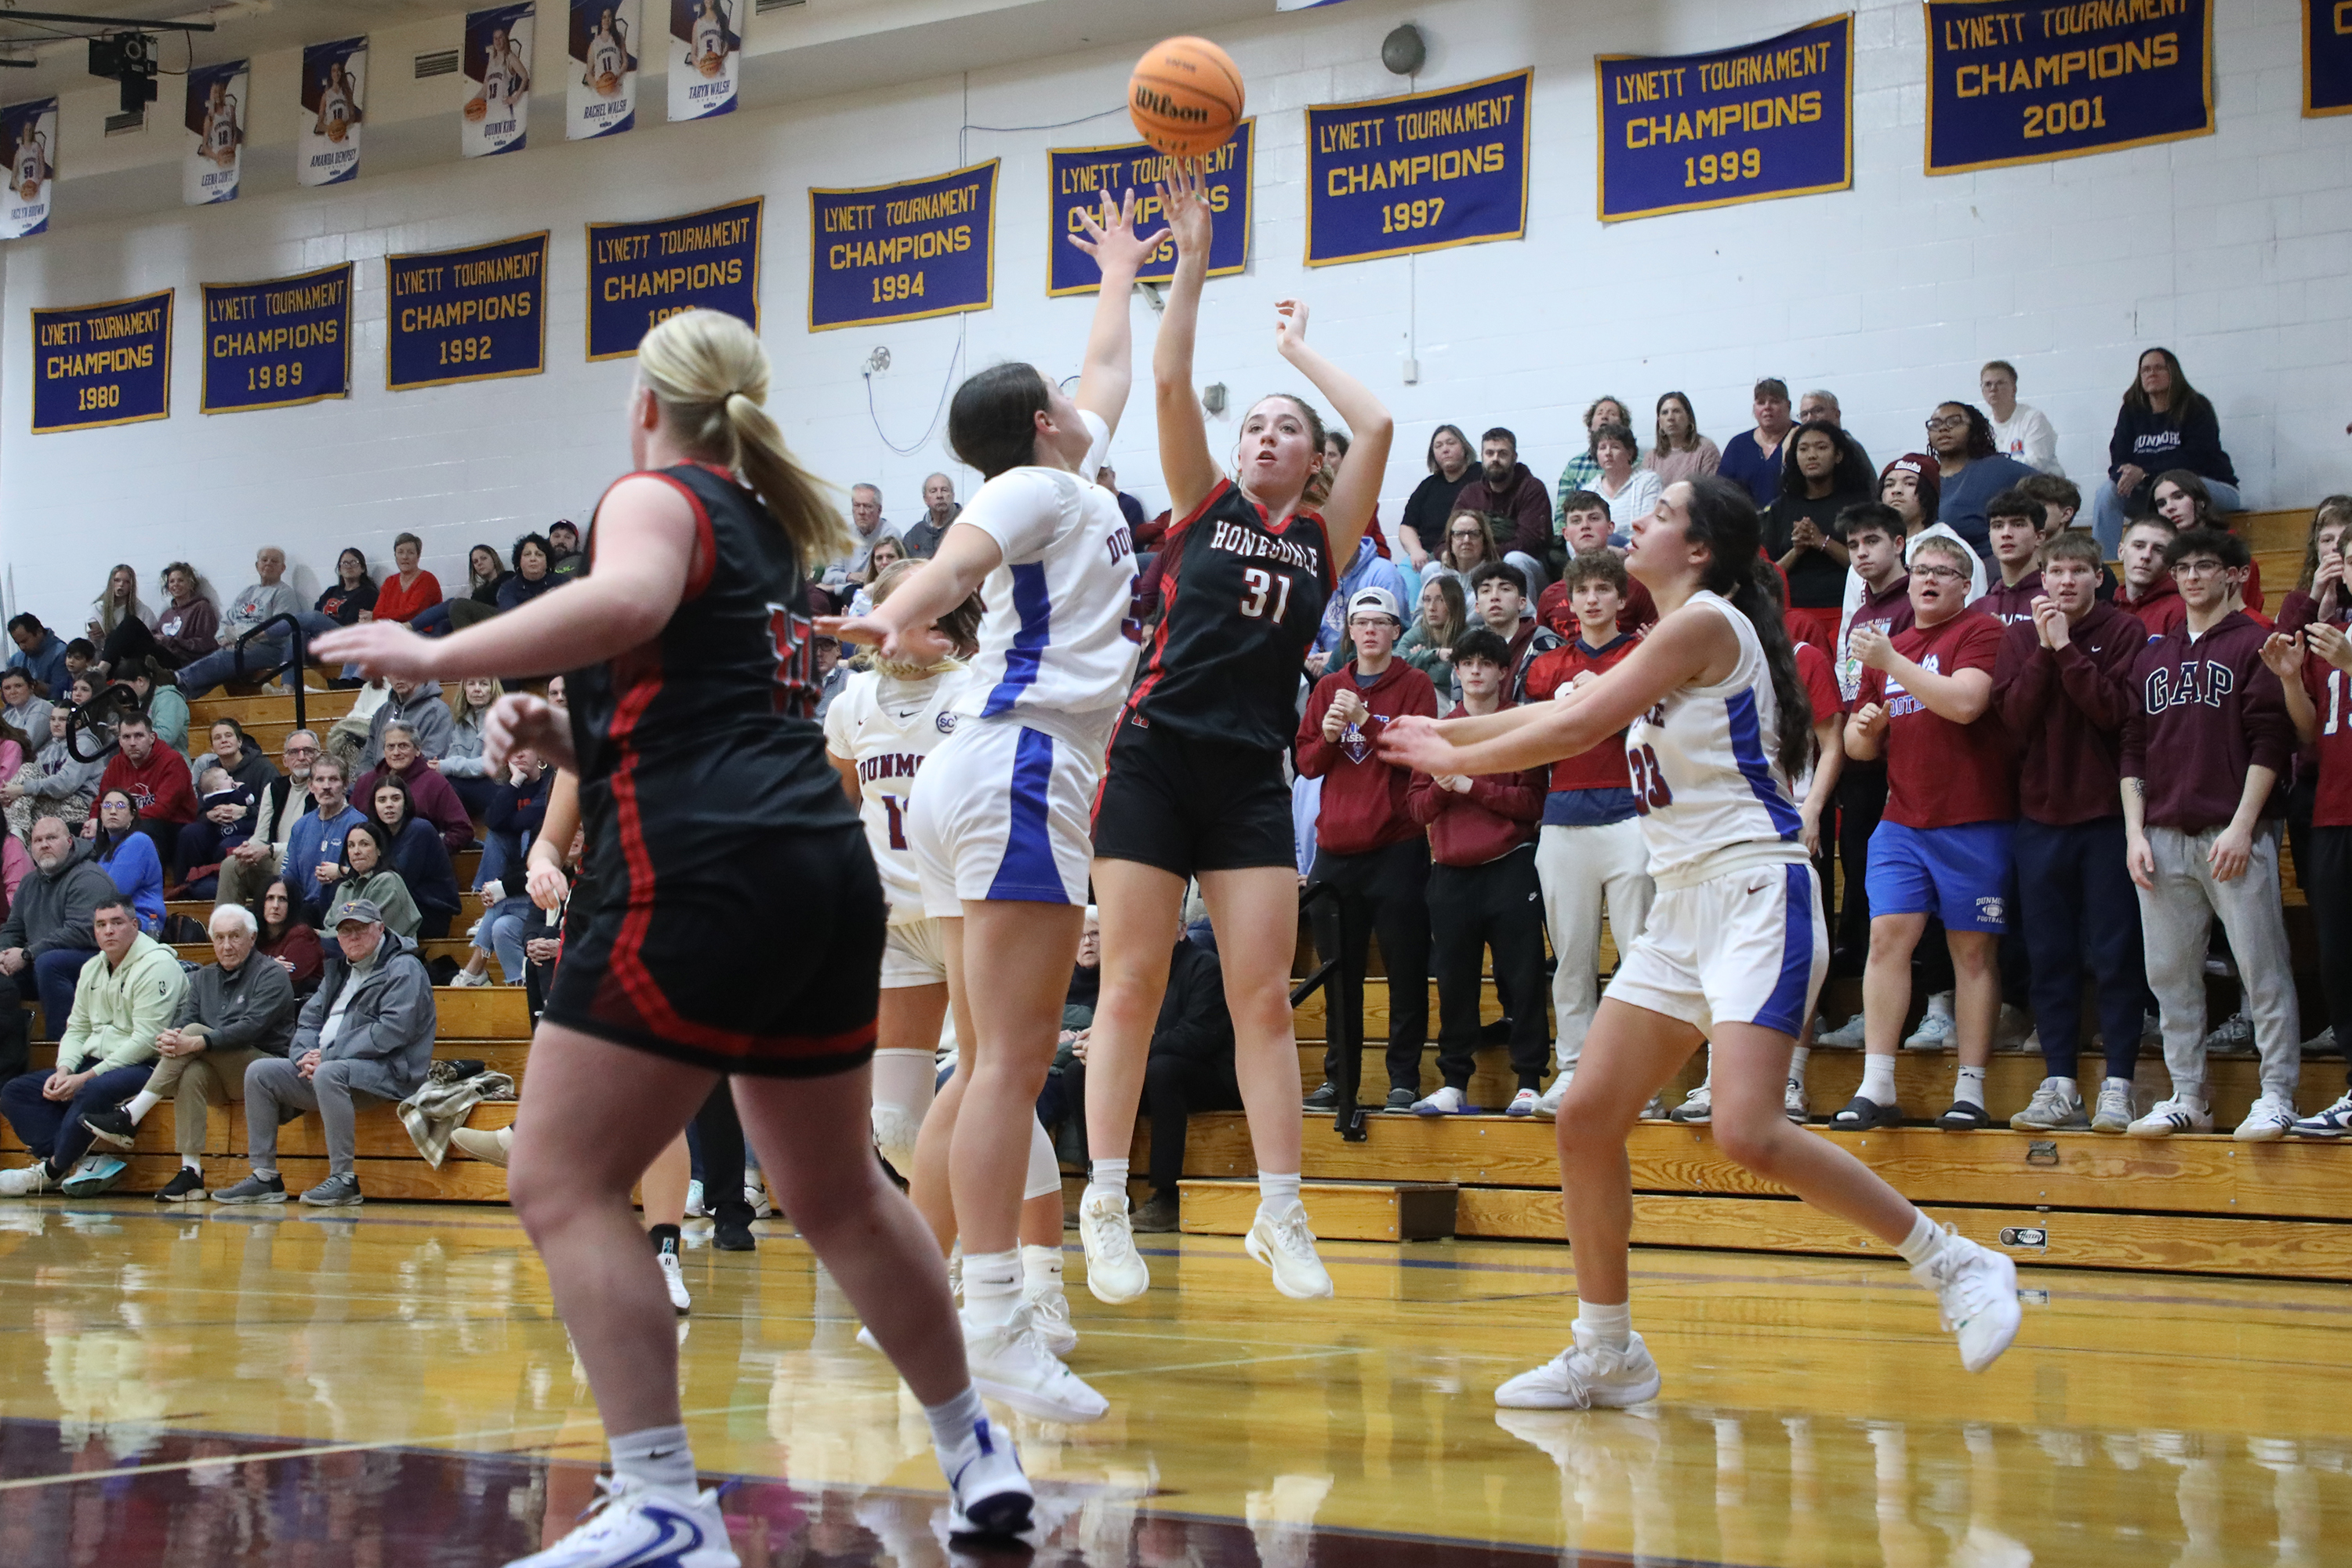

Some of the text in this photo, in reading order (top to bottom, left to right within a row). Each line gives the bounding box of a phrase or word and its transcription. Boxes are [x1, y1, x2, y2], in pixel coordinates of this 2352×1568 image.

[1945, 13, 2025, 51] LYNETT
[1616, 41, 1831, 105] LYNETT TOURNAMENT
[1956, 32, 2178, 98] CHAMPIONS
[710, 80, 731, 96] WALSH
[1136, 85, 1208, 123] Wilson
[583, 103, 607, 119] RACHEL
[608, 99, 627, 115] WALSH
[1320, 95, 1514, 154] LYNETT TOURNAMENT
[1626, 91, 1822, 149] CHAMPIONS
[2024, 95, 2106, 139] 2001
[1062, 163, 1122, 194] LYNETT
[1328, 143, 1504, 197] CHAMPIONS
[1685, 147, 1761, 187] 1999
[825, 184, 980, 233] LYNETT TOURNAMENT
[1382, 197, 1445, 234] 1997
[598, 217, 750, 264] LYNETT TOURNAMENT
[829, 225, 971, 270] CHAMPIONS
[396, 252, 539, 296] LYNETT TOURNAMENT
[604, 259, 742, 302] CHAMPIONS
[872, 271, 924, 303] 1994
[210, 279, 344, 322] LYNETT TOURNAMENT
[401, 292, 531, 332] CHAMPIONS
[42, 308, 161, 346] LYNETT TOURNAMENT
[213, 319, 338, 358] CHAMPIONS
[47, 344, 154, 379] CHAMPIONS
[440, 336, 492, 365] 1992
[249, 362, 303, 390] 1989
[78, 385, 119, 411] 1980
[1240, 567, 1293, 625] 31
[2146, 659, 2234, 715] GAP
[940, 718, 955, 728] SC
